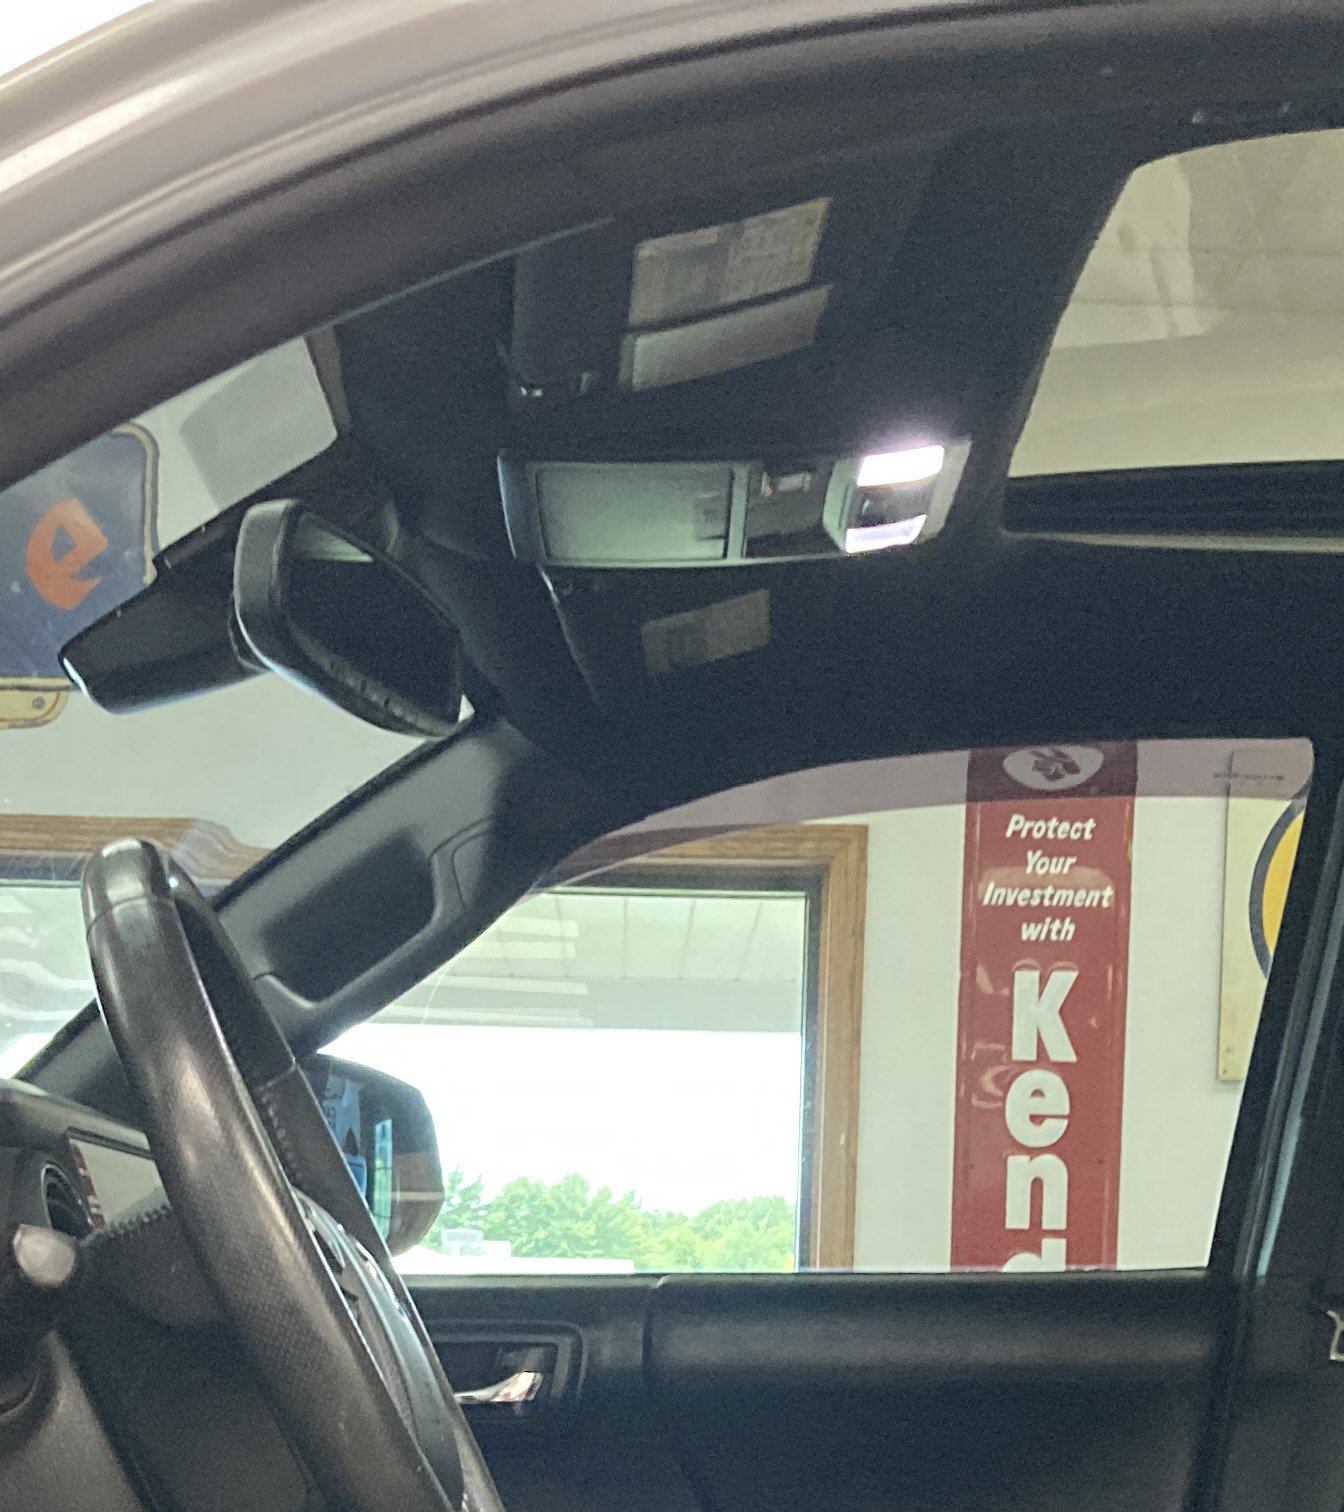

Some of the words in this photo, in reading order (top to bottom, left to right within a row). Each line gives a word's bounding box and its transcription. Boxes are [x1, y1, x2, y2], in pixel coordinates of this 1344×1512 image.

[1005, 813, 1097, 840] Protect
[1025, 850, 1077, 876] Your
[982, 881, 1114, 908] Investment
[1021, 917, 1076, 942] with
